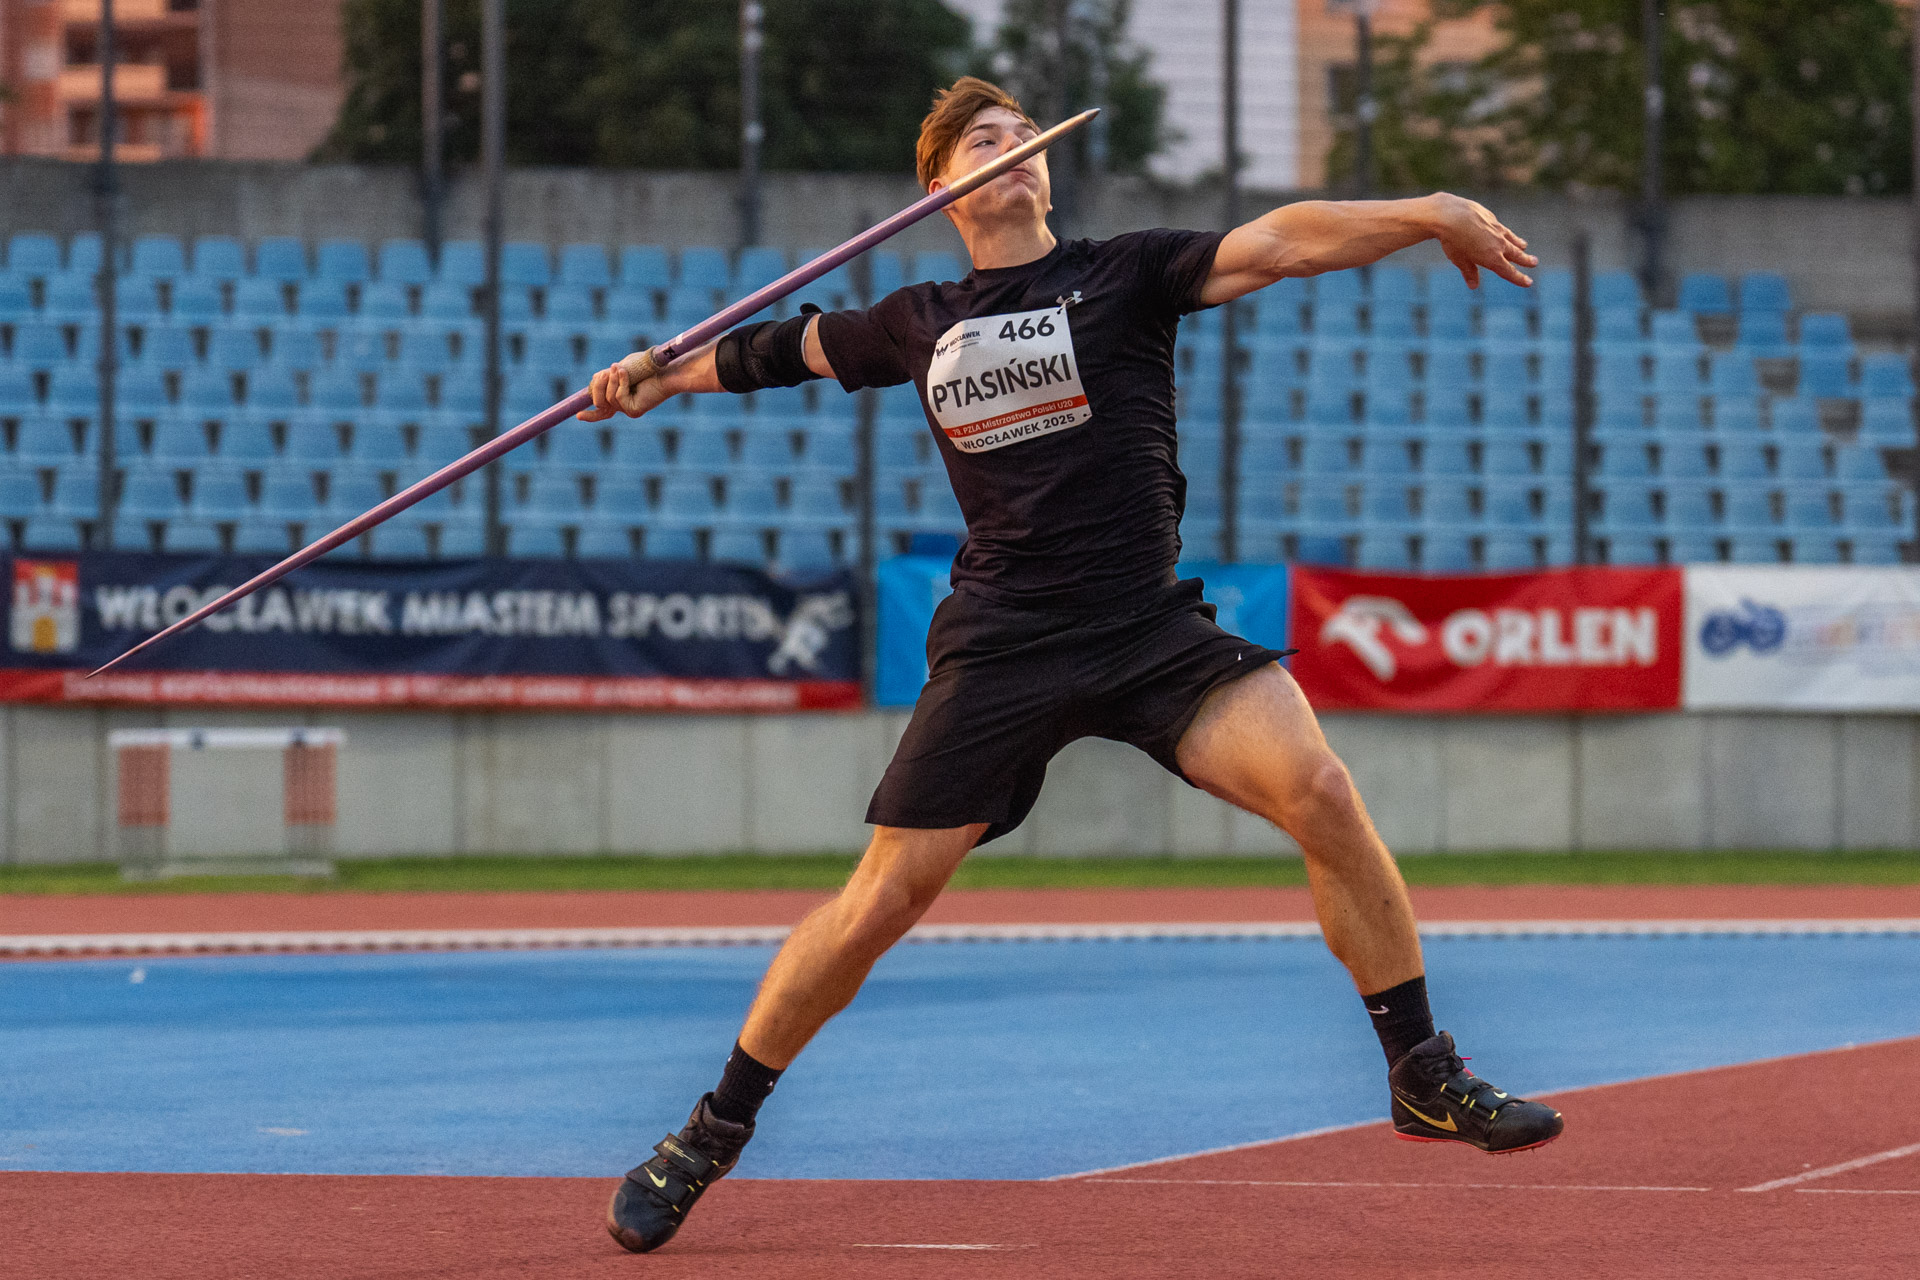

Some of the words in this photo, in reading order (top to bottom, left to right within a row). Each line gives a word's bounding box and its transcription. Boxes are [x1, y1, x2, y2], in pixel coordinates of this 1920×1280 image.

[998, 315, 1055, 342] 466
[931, 353, 1072, 413] PTASIŃSKI
[960, 422, 1041, 450] WŁOCŁAWEK
[1043, 413, 1075, 430] 2025
[963, 425, 981, 435] PZLA
[982, 410, 1032, 430] Mistrzostwa
[1032, 404, 1056, 417] Polski
[1057, 399, 1074, 410] U20
[401, 589, 601, 637] MIASTEM
[1442, 606, 1656, 667] ORLEN
